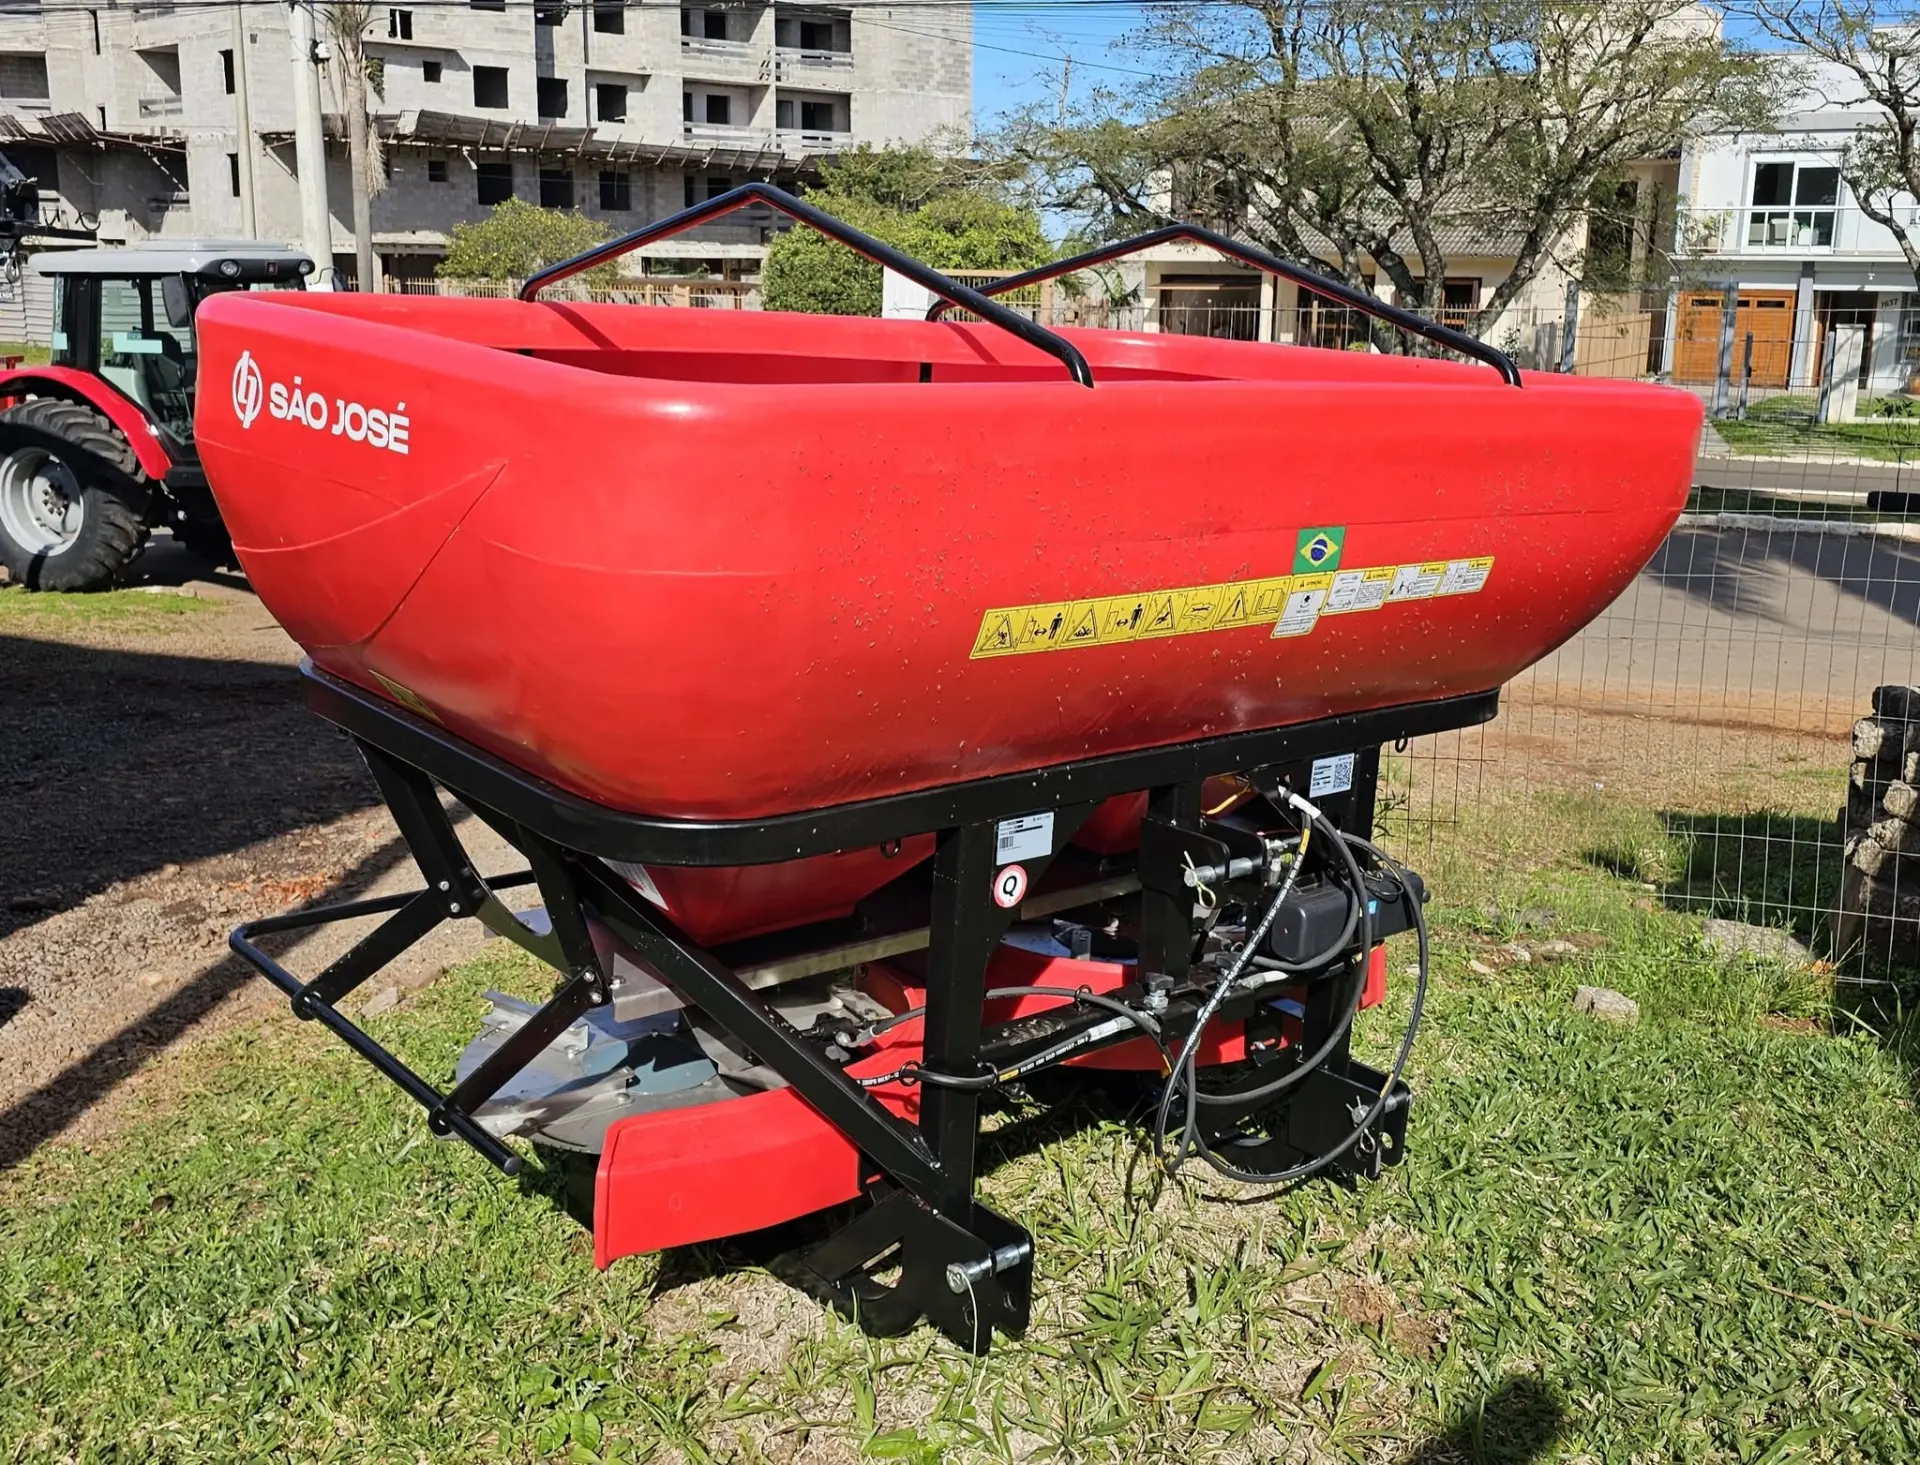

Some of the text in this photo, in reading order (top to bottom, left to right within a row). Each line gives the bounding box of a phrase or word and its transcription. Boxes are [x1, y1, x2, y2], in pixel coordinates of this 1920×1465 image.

[269, 375, 410, 455] SÃO JOSÉ
[1002, 875, 1018, 897] Q
